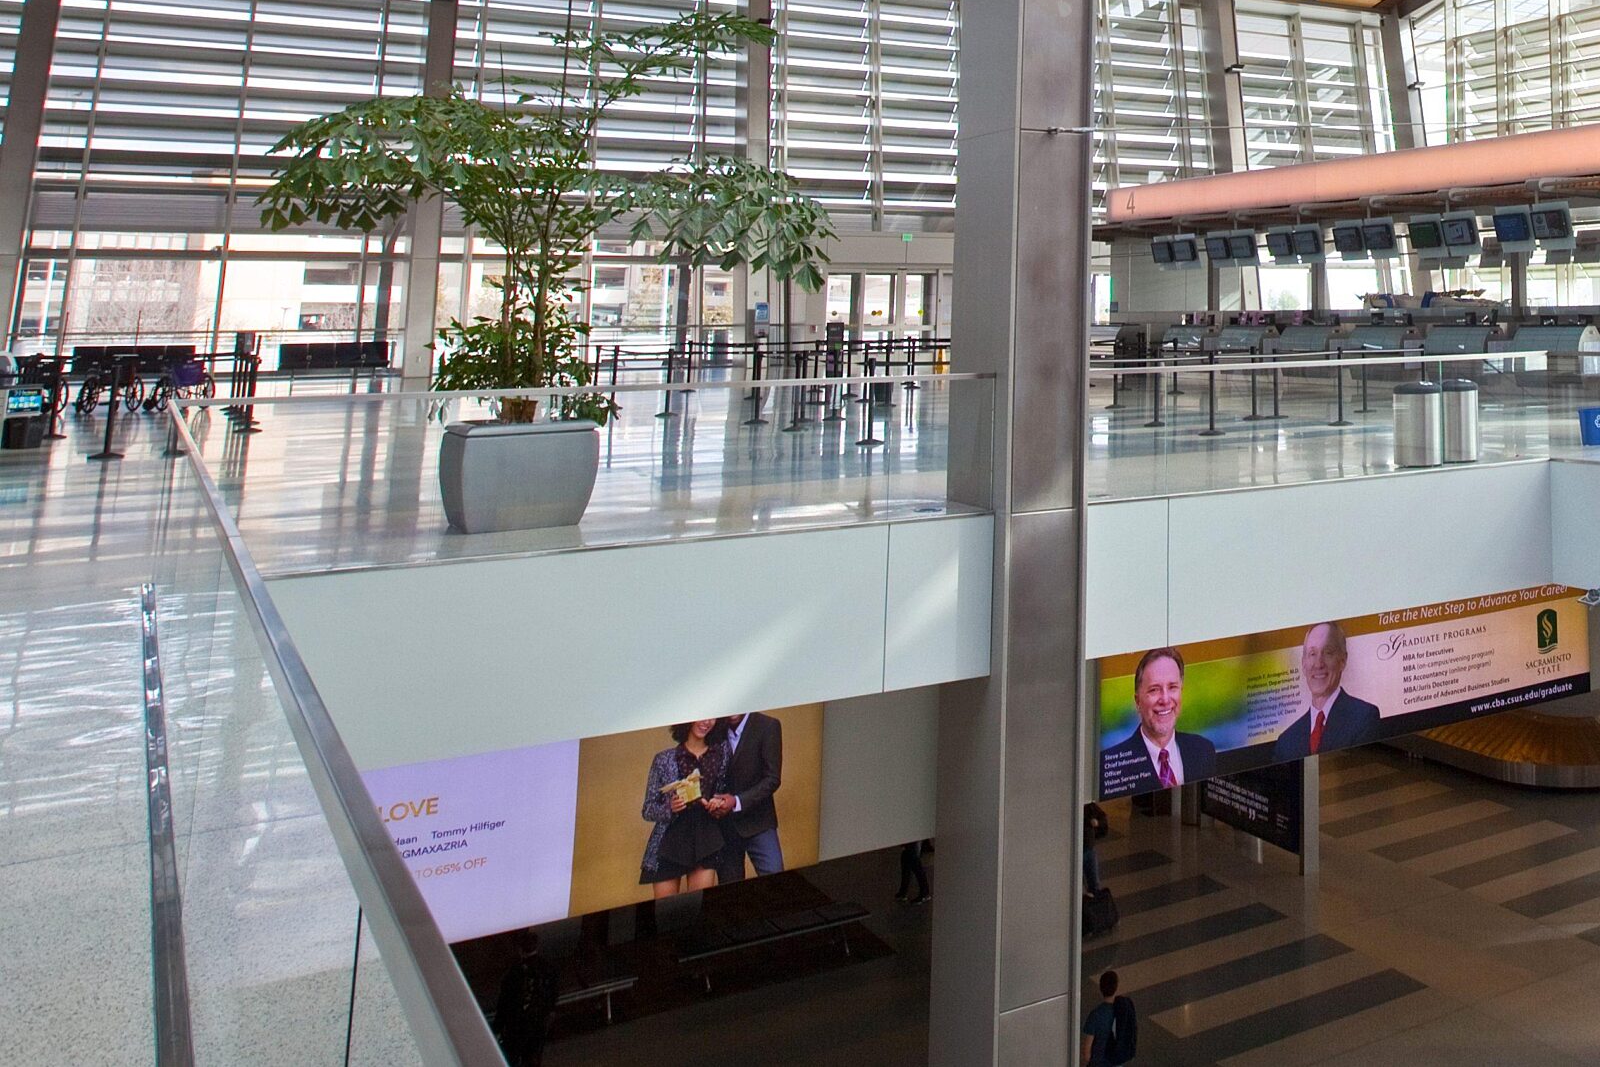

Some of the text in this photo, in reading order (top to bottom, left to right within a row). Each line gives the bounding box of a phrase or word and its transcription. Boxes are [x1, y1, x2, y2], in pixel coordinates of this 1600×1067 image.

[1126, 191, 1136, 214] 4
[1378, 584, 1569, 626] Take the Next Step to Advance Your Career
[1443, 625, 1487, 640] PROGRAMS
[1402, 647, 1454, 661] MBA for Executives
[1403, 663, 1416, 672] MBA
[1471, 648, 1495, 661] program)
[1525, 652, 1572, 670] SACRAMENTO
[1403, 675, 1413, 683] MS
[1413, 669, 1448, 682] Accountancy
[1468, 660, 1492, 673] program)
[1537, 664, 1561, 676] STATE
[1403, 676, 1510, 706] Certificate of Advanced Business Studies
[1432, 677, 1460, 689] Doctorate
[1470, 682, 1573, 713] www.cba.csus.edu/graduate
[1104, 750, 1132, 761] Steve Scott
[1104, 755, 1147, 770] Chief Information
[1104, 770, 1121, 778] Officer
[1104, 778, 1120, 786] Vision
[1120, 774, 1139, 783] Service
[1104, 785, 1128, 795] Alumnus
[432, 827, 468, 839] Tommy
[470, 820, 506, 833] Hilfiger
[401, 839, 468, 859] GMAXAZRIA
[434, 862, 461, 876] 65%
[463, 857, 488, 870] OFF
